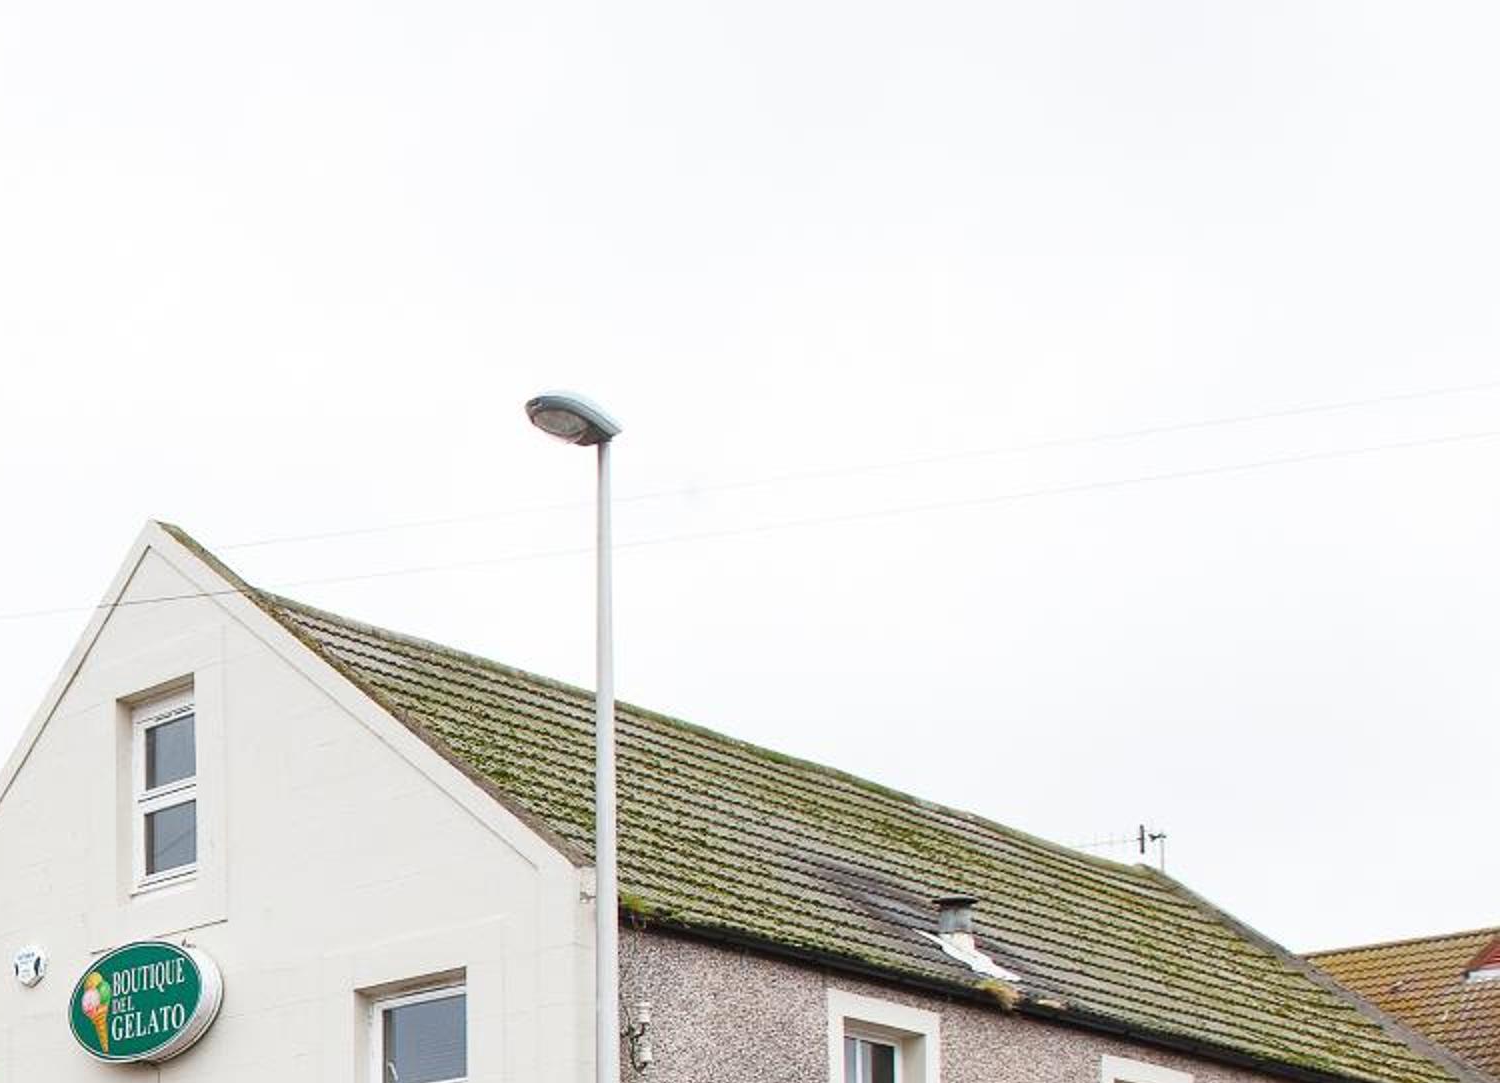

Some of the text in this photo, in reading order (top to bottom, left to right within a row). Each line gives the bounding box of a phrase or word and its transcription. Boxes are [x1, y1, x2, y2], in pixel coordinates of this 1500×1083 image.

[113, 957, 185, 997] BOUTIQUE
[111, 1003, 185, 1041] GELATO
[112, 995, 135, 1014] DEL
